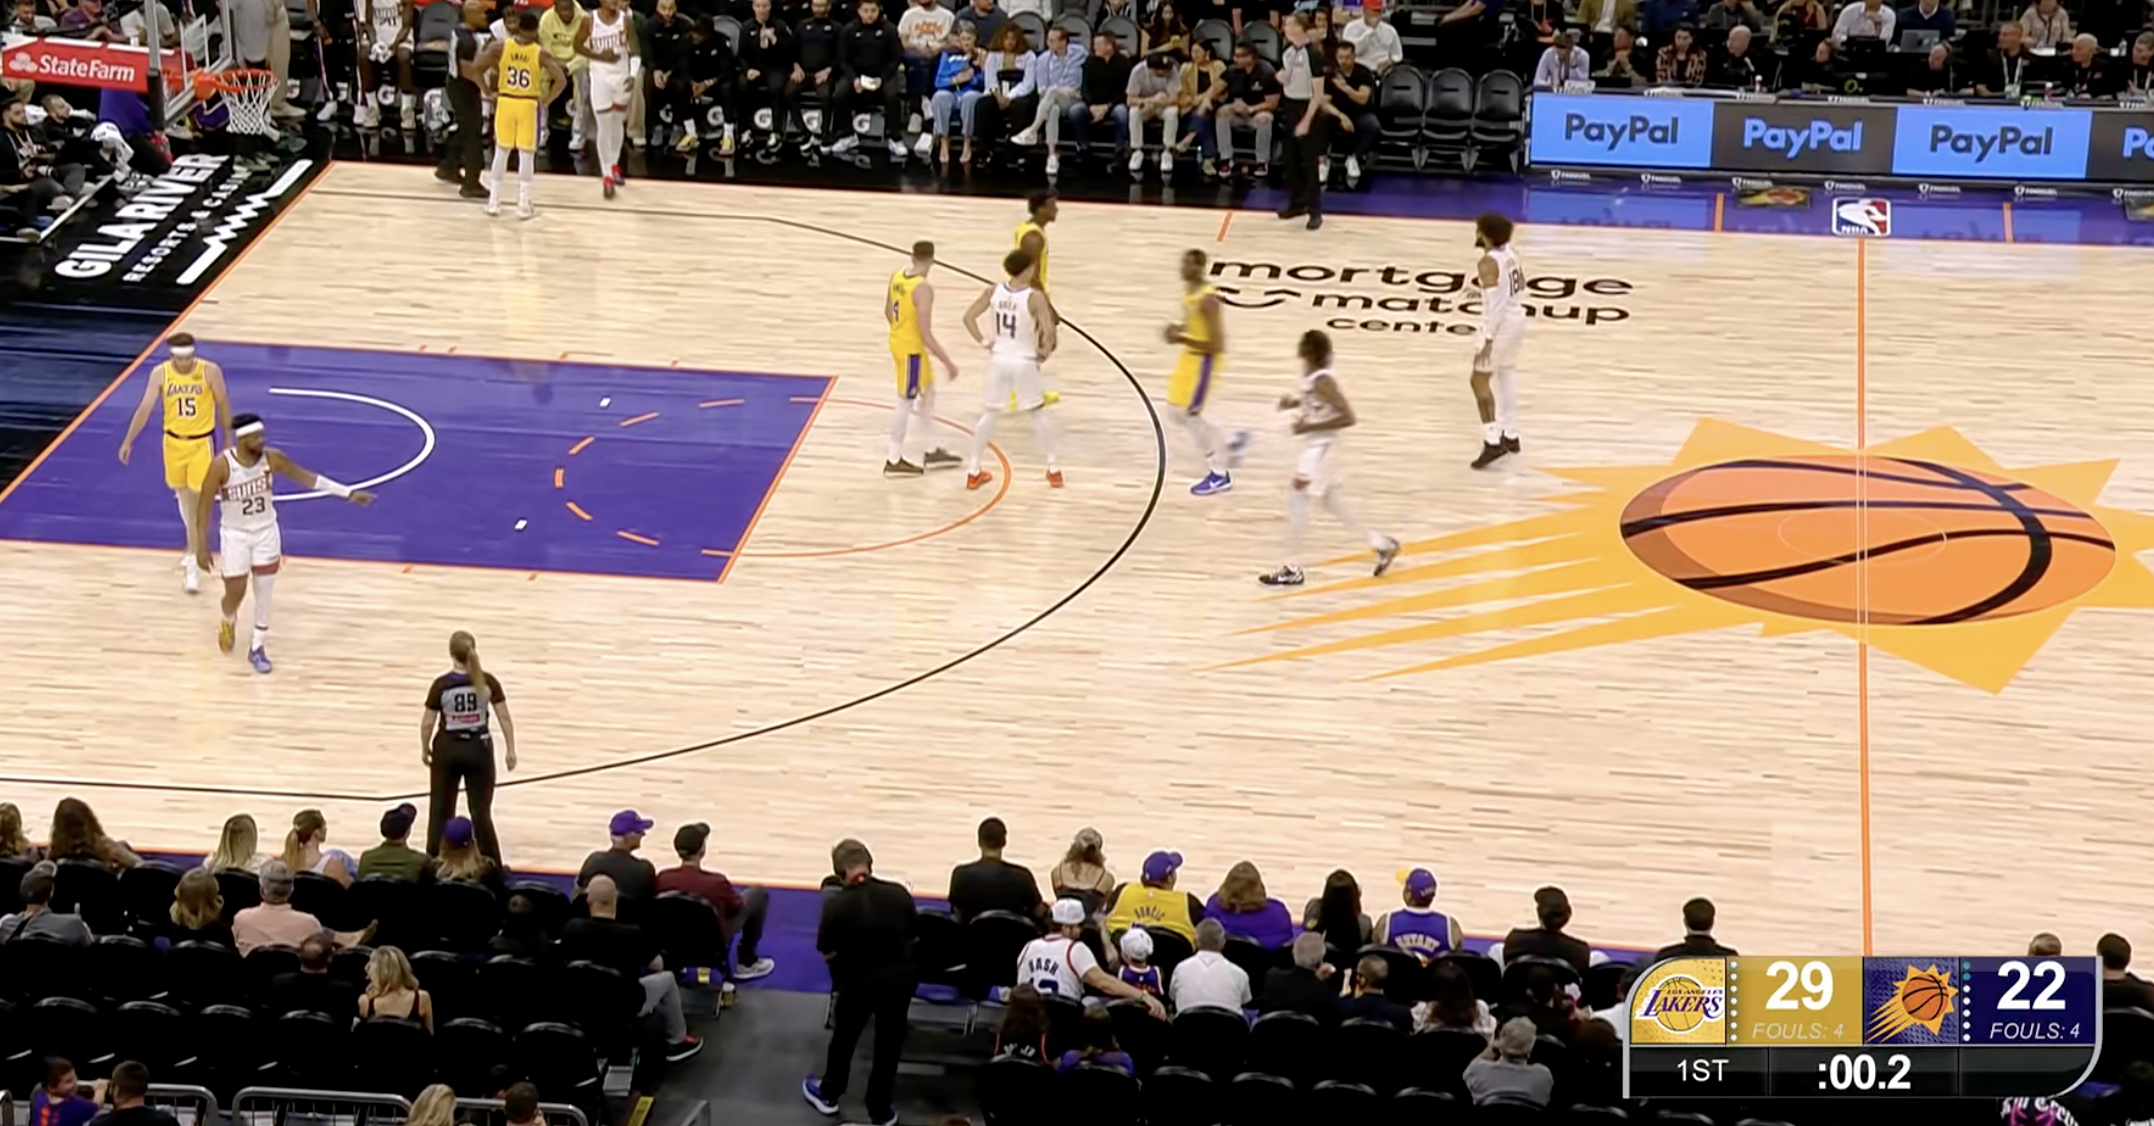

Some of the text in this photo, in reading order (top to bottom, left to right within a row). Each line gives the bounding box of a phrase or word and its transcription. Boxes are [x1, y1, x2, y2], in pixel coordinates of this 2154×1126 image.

[507, 65, 530, 88] 36
[754, 107, 772, 130] G
[853, 113, 871, 134] G
[1565, 113, 1679, 151] PayPal
[1743, 117, 1864, 159] PayPal
[1929, 124, 2053, 163] PayPal
[55, 153, 230, 278] GILA RIVER
[122, 222, 197, 282] RESORTS
[995, 311, 1016, 339] 14
[1327, 317, 1478, 335] cente
[177, 397, 196, 416] 15
[242, 496, 266, 516] 23
